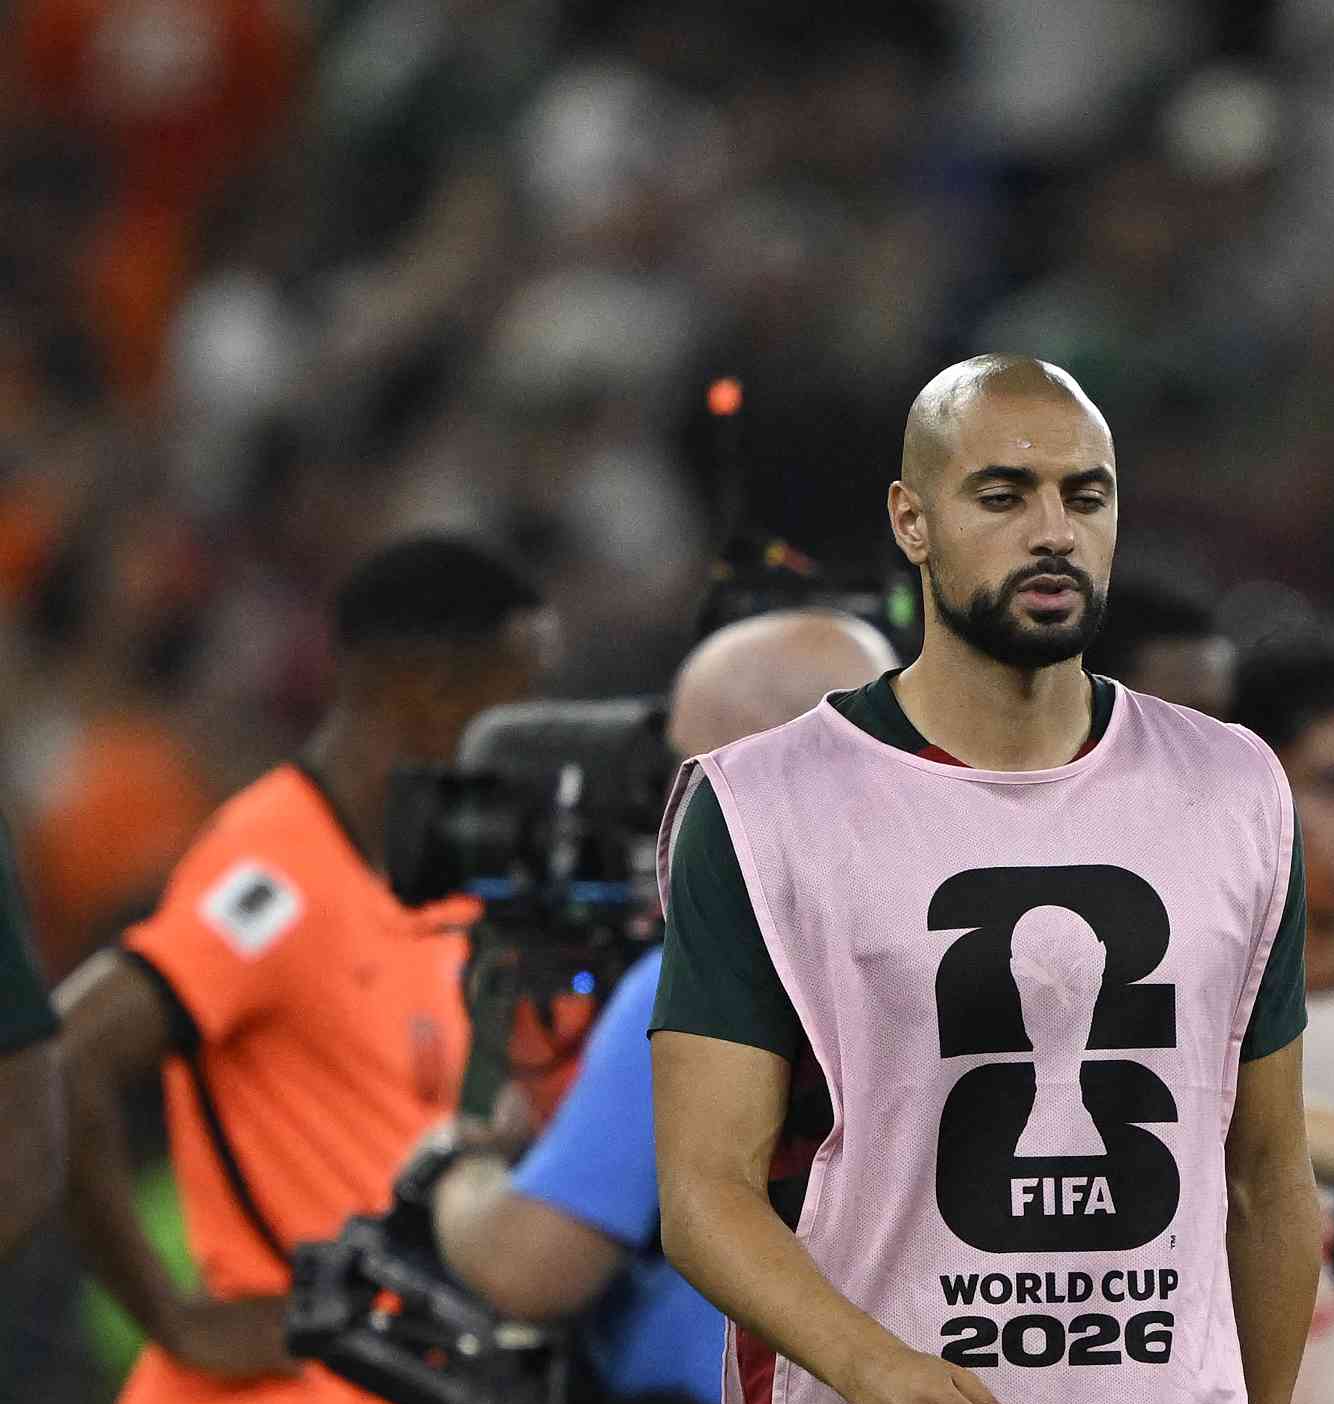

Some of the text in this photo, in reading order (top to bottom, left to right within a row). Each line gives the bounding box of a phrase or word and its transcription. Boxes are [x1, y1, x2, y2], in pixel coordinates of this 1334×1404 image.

[1010, 1176, 1117, 1217] FIFA
[939, 1268, 1179, 1306] WORLD CUP
[940, 1310, 1175, 1368] 2026
